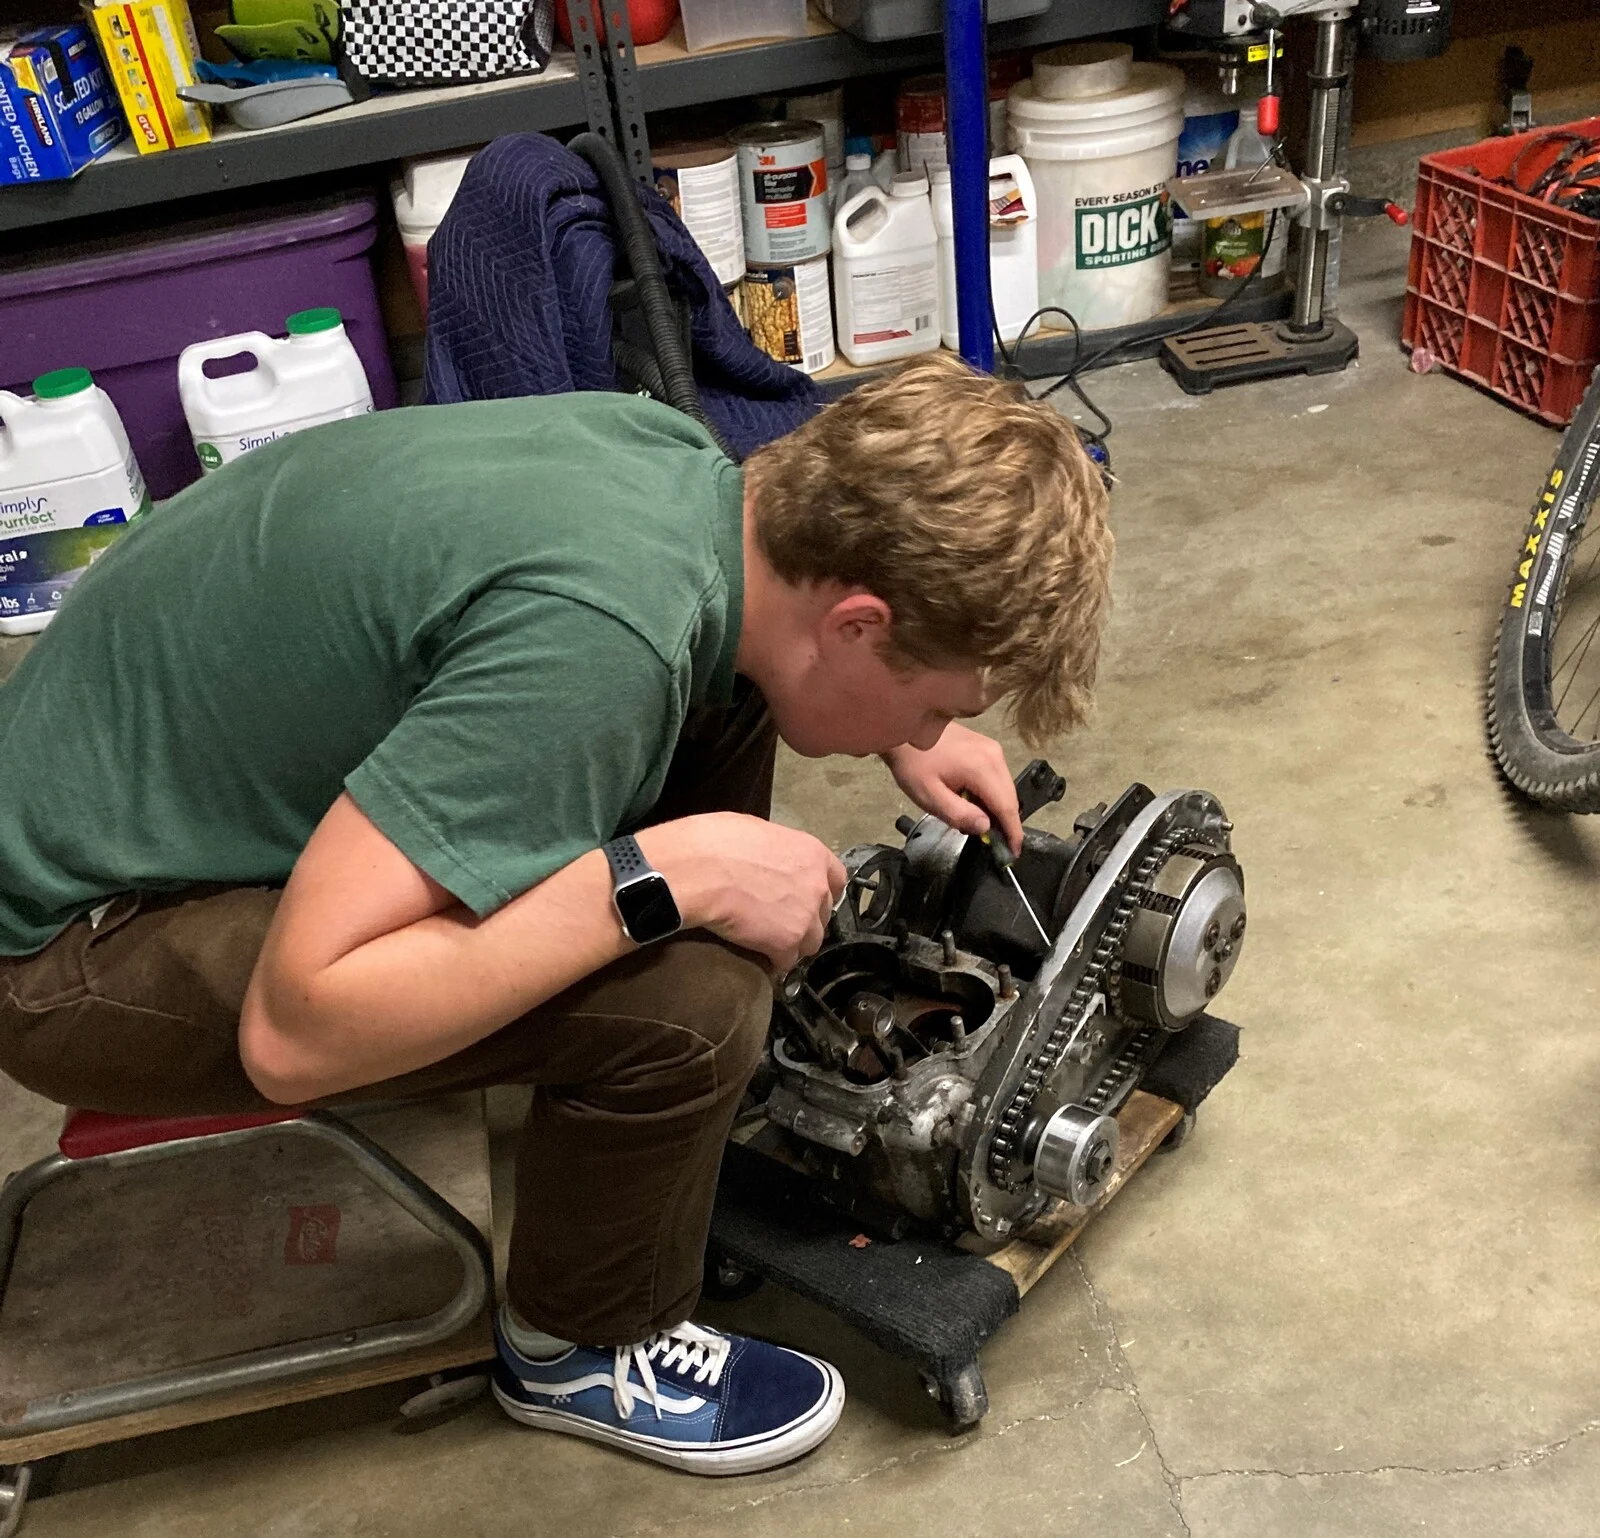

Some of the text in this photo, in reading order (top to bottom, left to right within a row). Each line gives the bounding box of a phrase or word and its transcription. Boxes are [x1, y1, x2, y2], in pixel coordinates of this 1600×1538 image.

[0, 76, 17, 122] ENTED
[10, 125, 40, 178] KITCHEN
[29, 97, 53, 146] KIRKLAND
[138, 115, 157, 143] GLAD
[9, 157, 23, 179] Bags
[759, 156, 775, 165] 3M
[1176, 160, 1209, 177] ne
[1075, 196, 1109, 207] EVERY
[1113, 187, 1151, 203] SEASON
[1081, 201, 1160, 254] DICK
[1085, 247, 1147, 265] SPORTING
[0, 496, 47, 514] imply
[1511, 469, 1563, 608] MAXXIS
